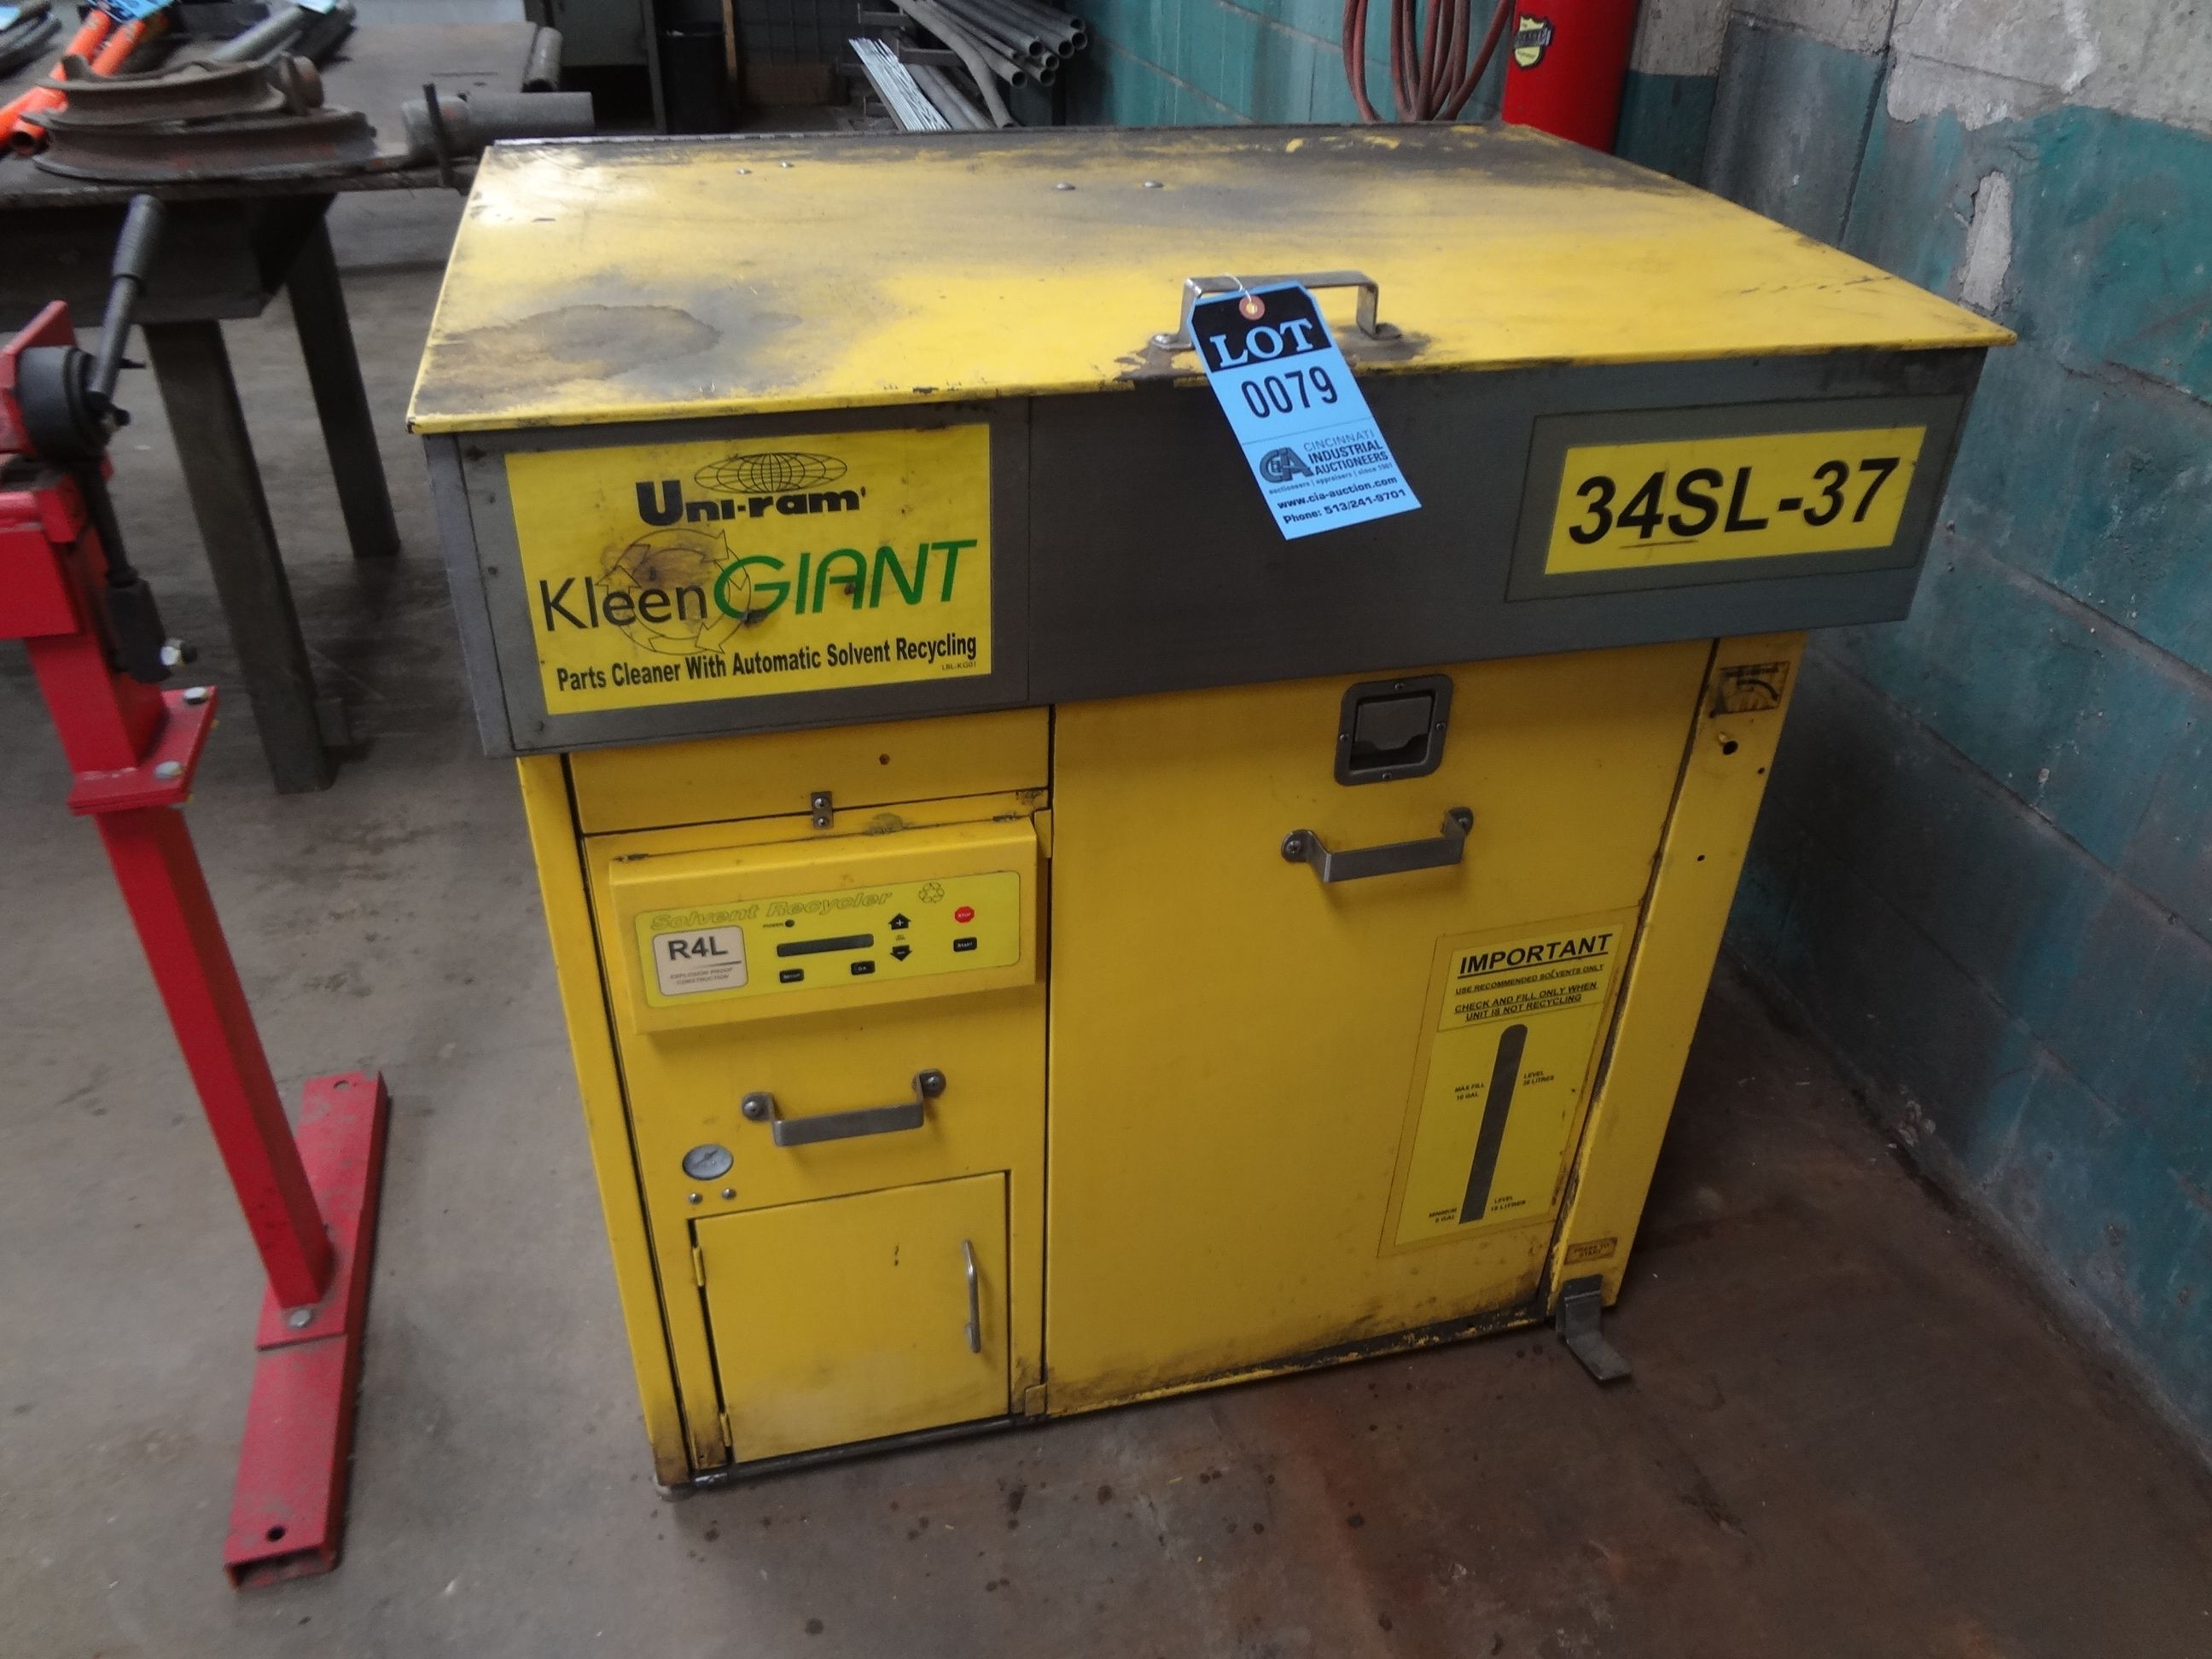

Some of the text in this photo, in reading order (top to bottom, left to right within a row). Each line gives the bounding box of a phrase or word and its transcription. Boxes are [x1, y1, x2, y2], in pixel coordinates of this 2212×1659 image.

[1209, 317, 1313, 369] LOT
[1240, 365, 1338, 418] 0079
[1303, 429, 1375, 451] CINCINNATI
[1307, 439, 1383, 464] INDUSTRIAL
[1315, 451, 1389, 476] AUCTIONEERS
[635, 480, 860, 527] Uni-ram
[1277, 475, 1398, 509] www.cia-auction.com
[1283, 489, 1406, 524] Phone: 513/241-9701
[1568, 457, 1901, 545] 34SL-37
[556, 632, 977, 692] Parts Cleaner With Automatic Solvent Recycling
[650, 891, 894, 930] Solvent Recycler
[667, 935, 729, 961] R4L
[1459, 933, 1613, 975] IMPORTANT
[1455, 963, 1605, 995] USE RECOMMENDED SOLVENTS ONLY
[1454, 981, 1598, 1014] CHECK AND FILL ONLY WHEN
[1466, 993, 1582, 1022] UNIT IS NOT RECYCLING
